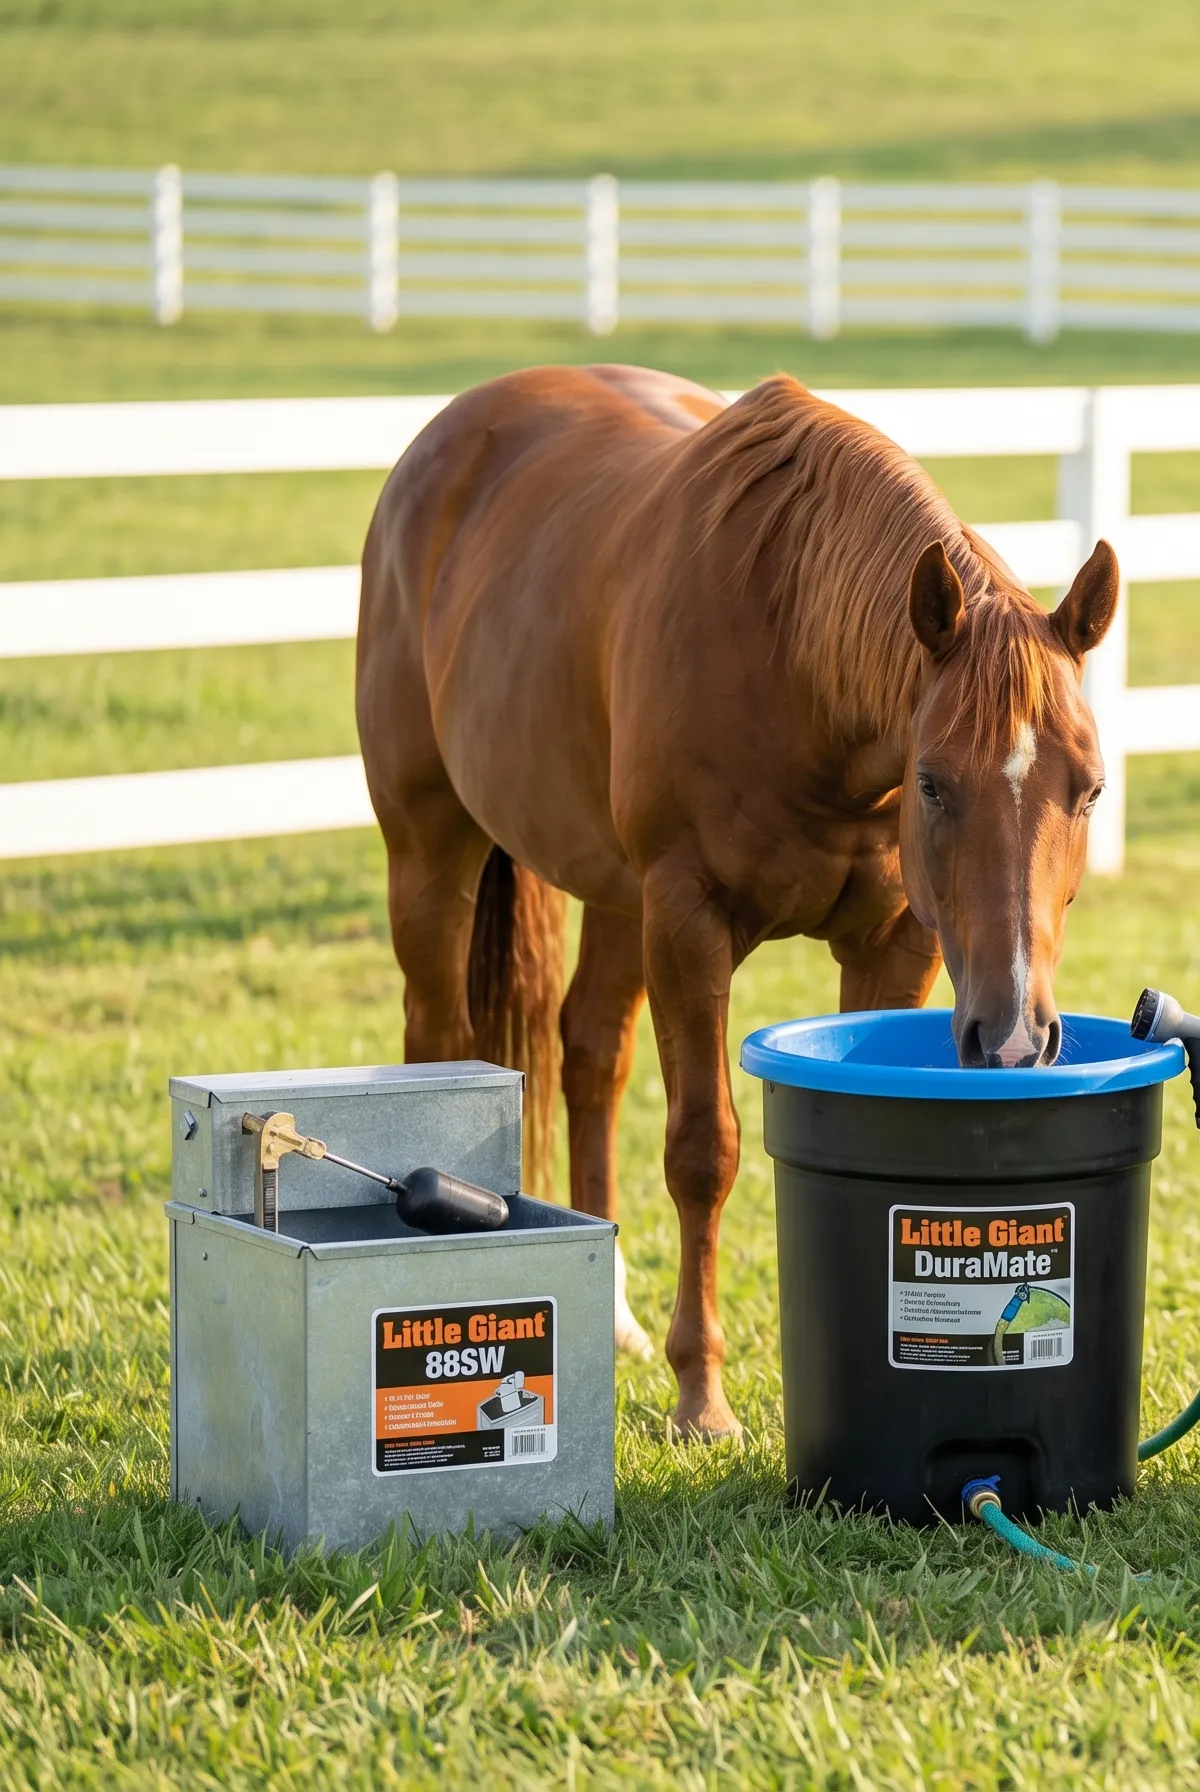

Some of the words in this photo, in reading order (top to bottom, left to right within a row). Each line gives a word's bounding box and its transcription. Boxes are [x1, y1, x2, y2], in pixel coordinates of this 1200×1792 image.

[901, 1218, 981, 1247] Little
[988, 1217, 1064, 1247] Giant
[915, 1250, 1051, 1279] DuraMate
[382, 1317, 462, 1349] Little
[468, 1311, 546, 1343] Giant
[425, 1345, 506, 1379] 88SW
